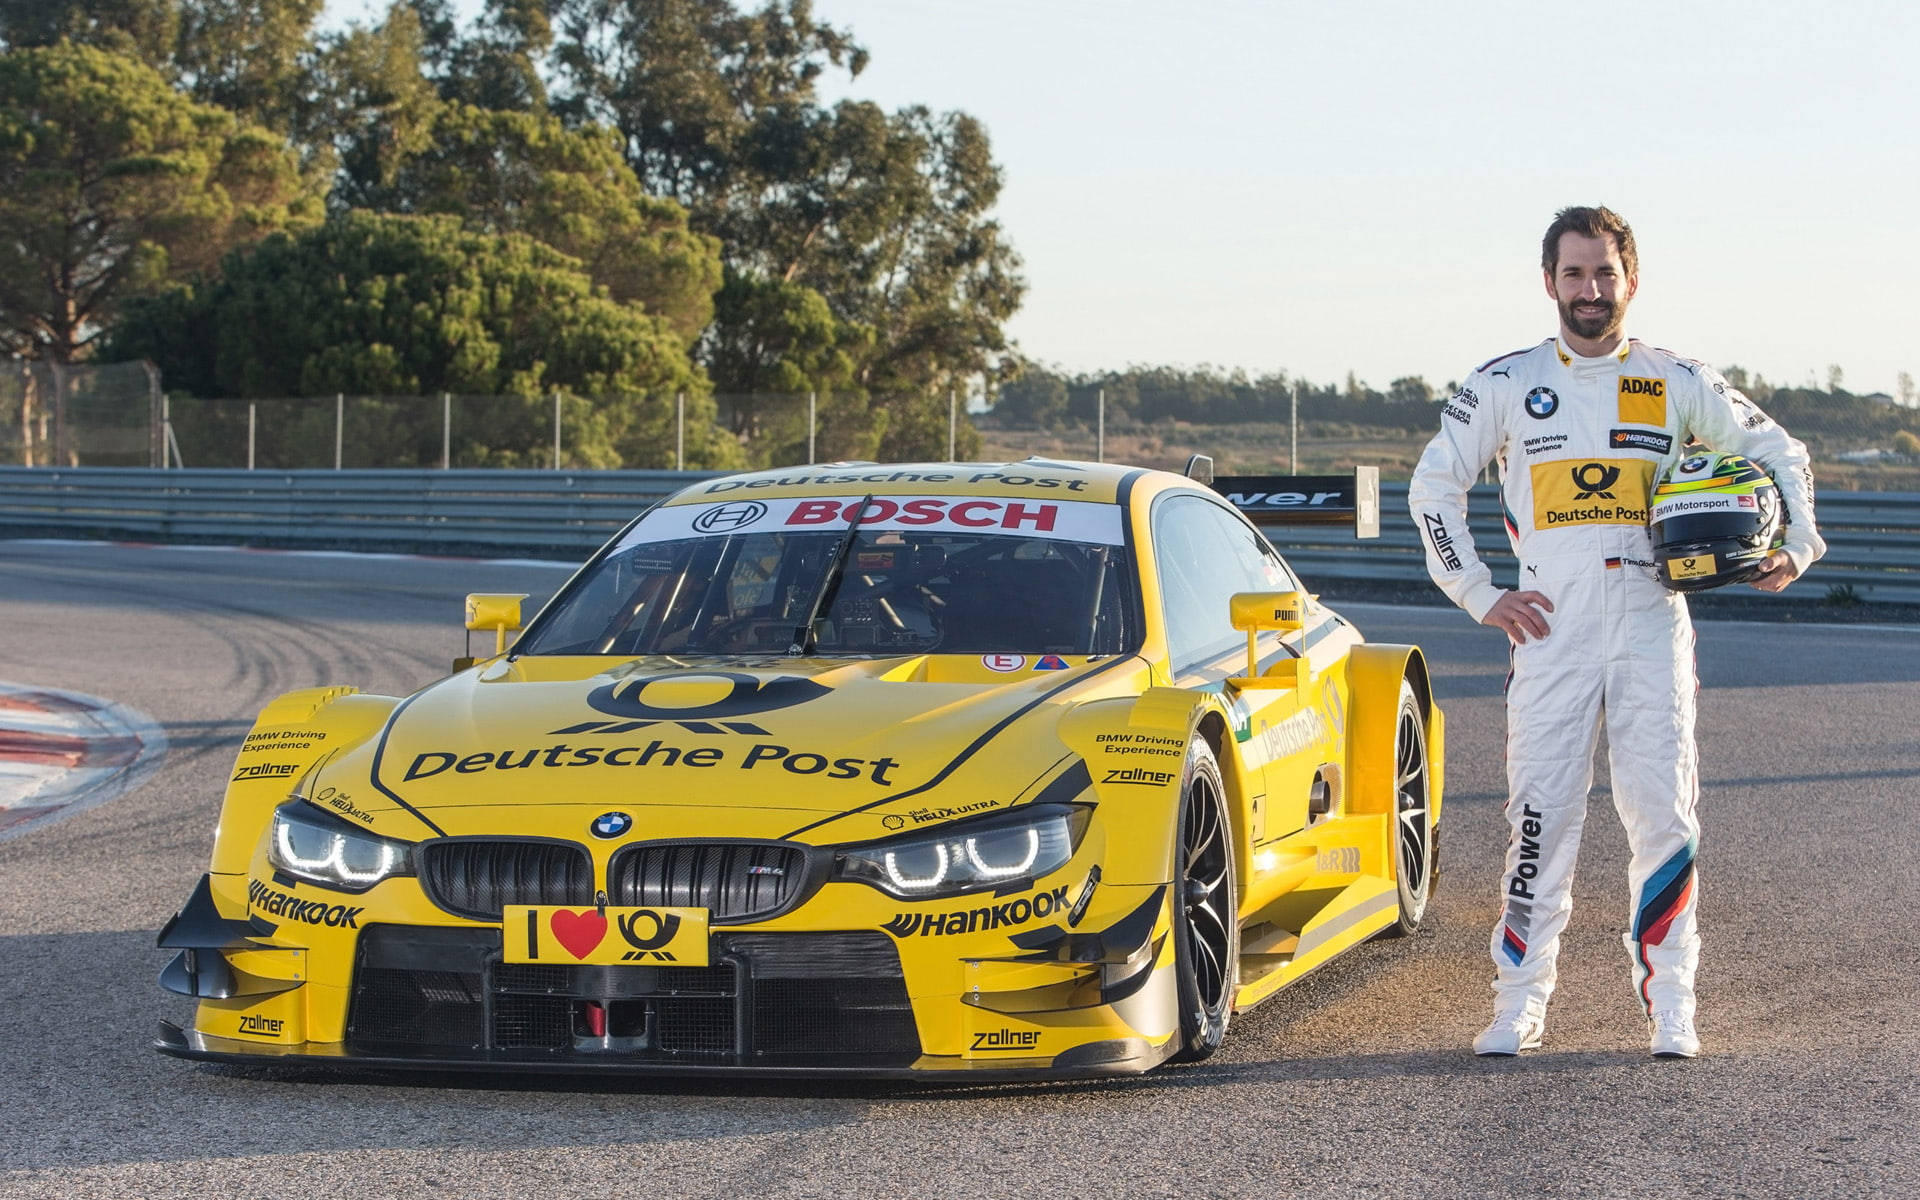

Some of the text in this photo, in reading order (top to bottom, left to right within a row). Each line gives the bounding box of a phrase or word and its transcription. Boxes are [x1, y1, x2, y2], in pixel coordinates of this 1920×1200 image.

[1621, 379, 1663, 396] ADAC
[1524, 434, 1568, 447] BMW Driving
[1526, 444, 1562, 455] Experience
[705, 471, 1089, 494] Deutsche Post
[785, 500, 1058, 531] BOSCH
[1547, 506, 1646, 524] Deutsche Post
[1656, 499, 1730, 517] BMW Motorsport
[247, 731, 326, 742] BMW Driving
[1096, 734, 1184, 747] BMW Driving
[242, 742, 310, 752] Experience
[1105, 744, 1181, 756] Experience
[402, 740, 899, 786] Deutsche Post
[912, 799, 1000, 823] HELIX ULTRA
[1508, 803, 1543, 900] Power
[527, 909, 539, 960] I
